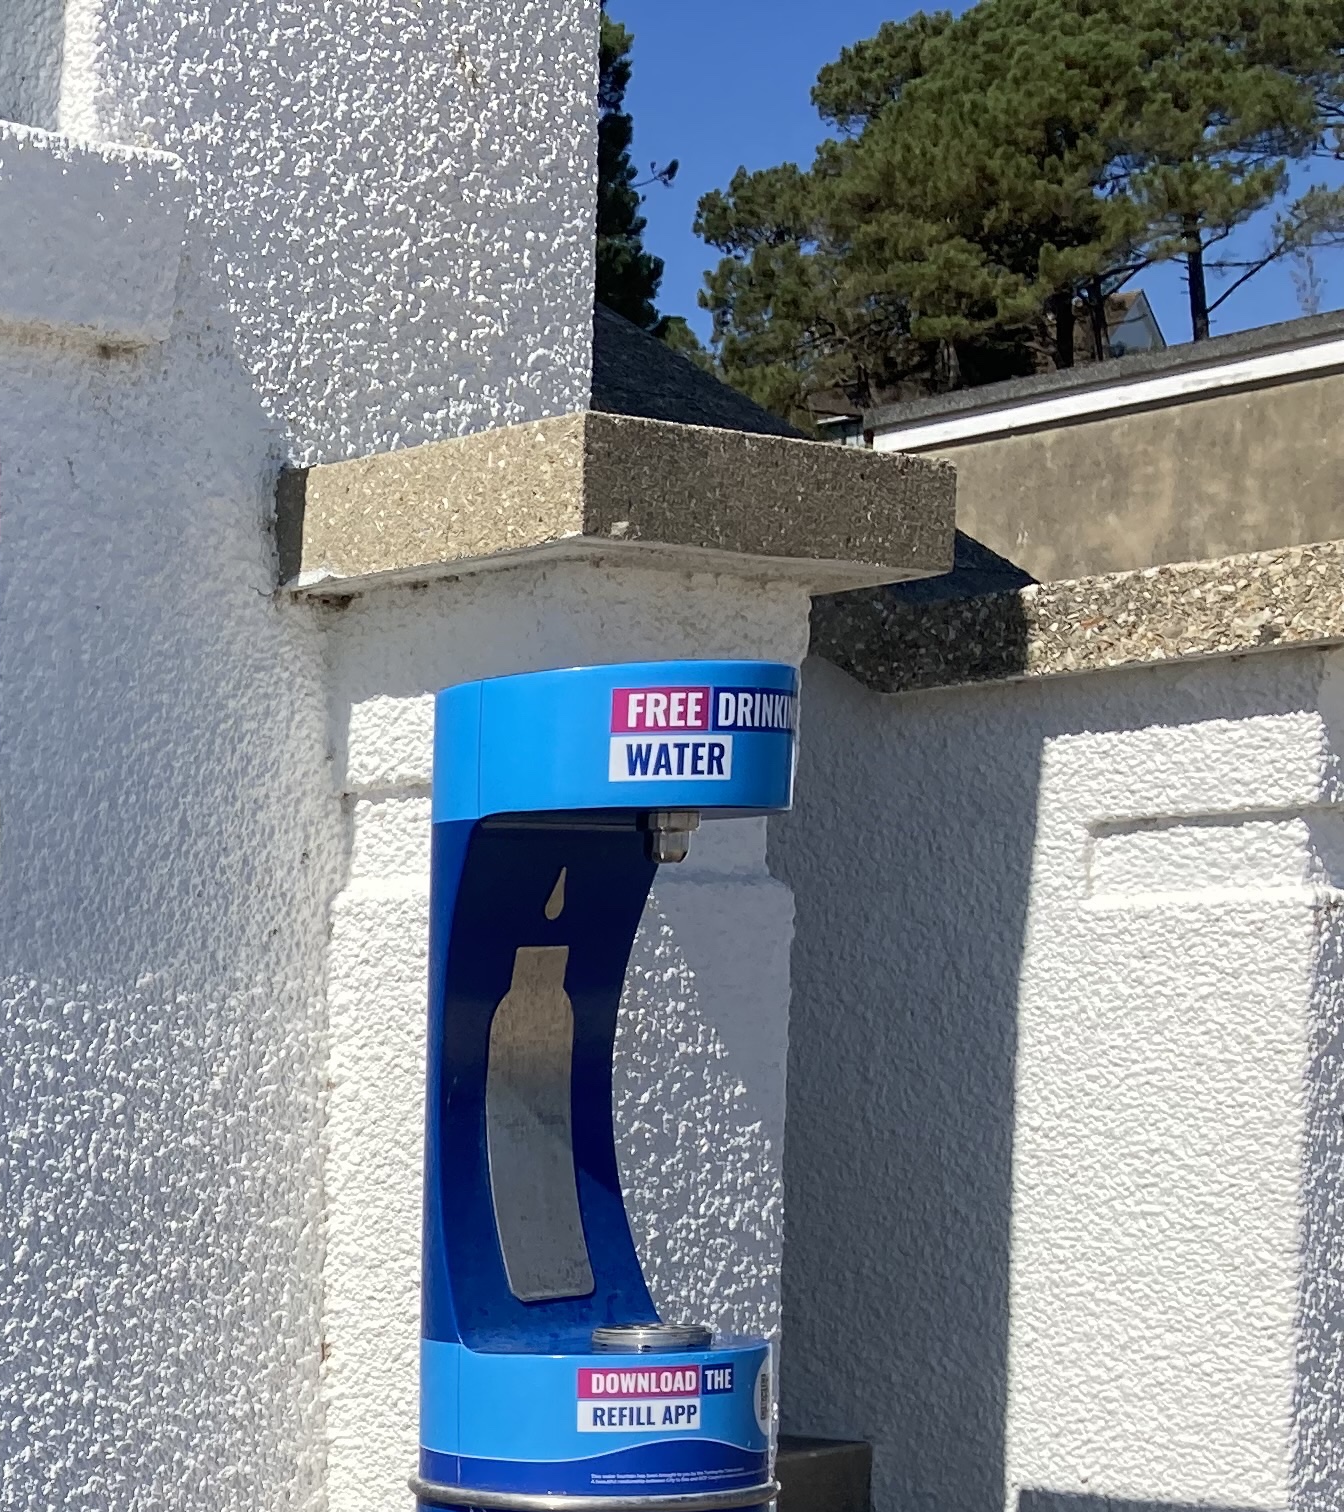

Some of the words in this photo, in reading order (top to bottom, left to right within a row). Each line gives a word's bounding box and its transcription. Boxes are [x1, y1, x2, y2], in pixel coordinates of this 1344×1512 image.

[627, 692, 703, 728] FREE
[626, 742, 725, 776] WATER
[591, 1370, 697, 1394] DOWNLOAD
[704, 1367, 733, 1390] THE
[592, 1405, 656, 1427] REFILL
[662, 1404, 698, 1425] APP
